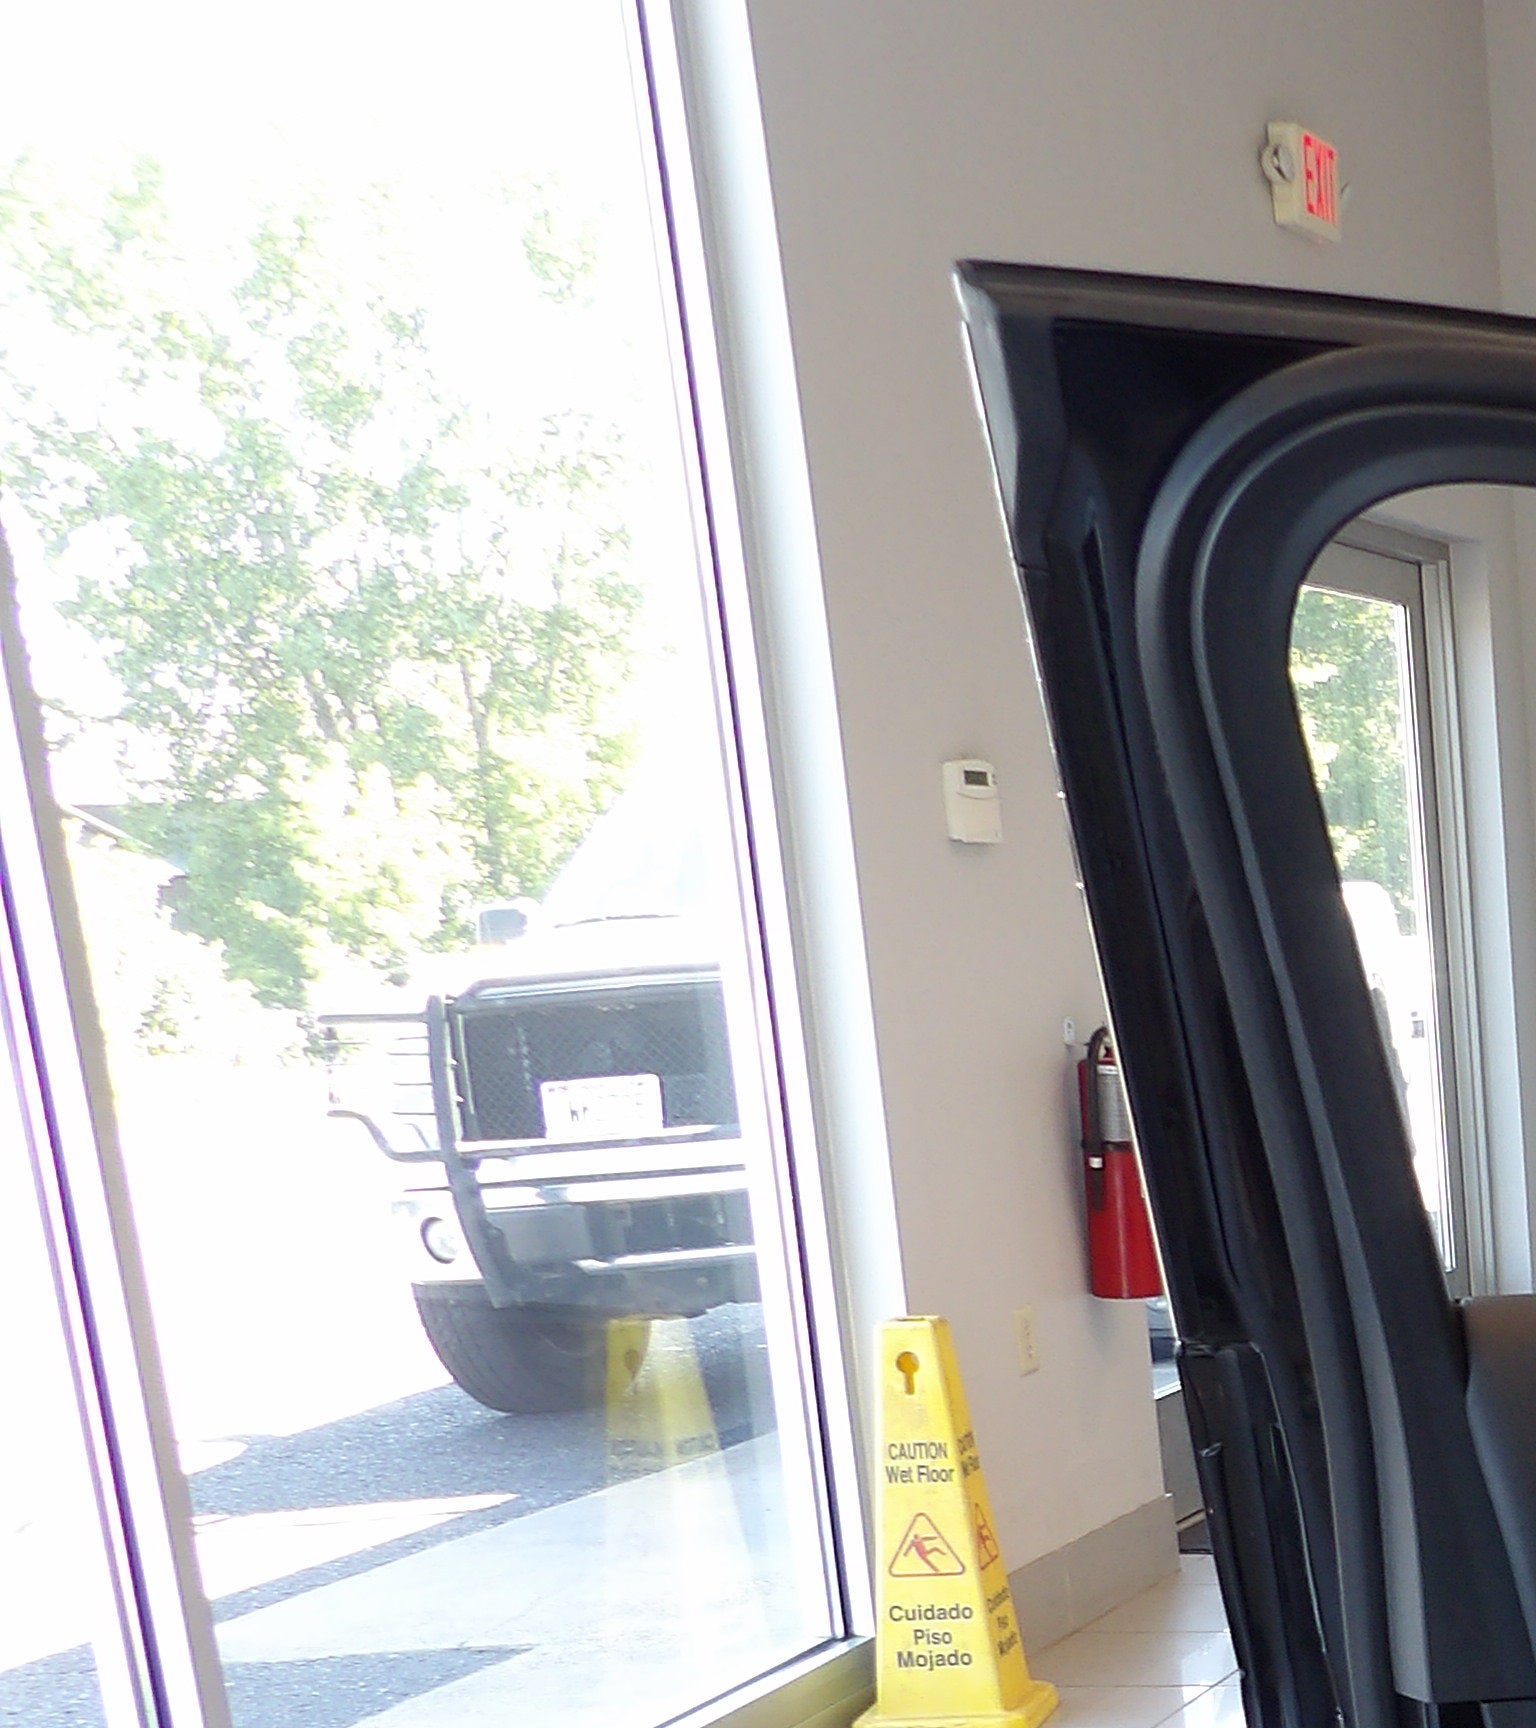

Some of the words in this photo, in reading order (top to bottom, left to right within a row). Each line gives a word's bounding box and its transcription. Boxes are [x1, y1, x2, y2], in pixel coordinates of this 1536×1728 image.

[888, 1442, 948, 1460] CAUTION
[885, 1465, 914, 1483] Wet
[917, 1464, 955, 1483] Floor
[889, 1603, 974, 1621] Cuidado
[913, 1628, 953, 1645] Piso
[897, 1649, 972, 1671] Mojado
